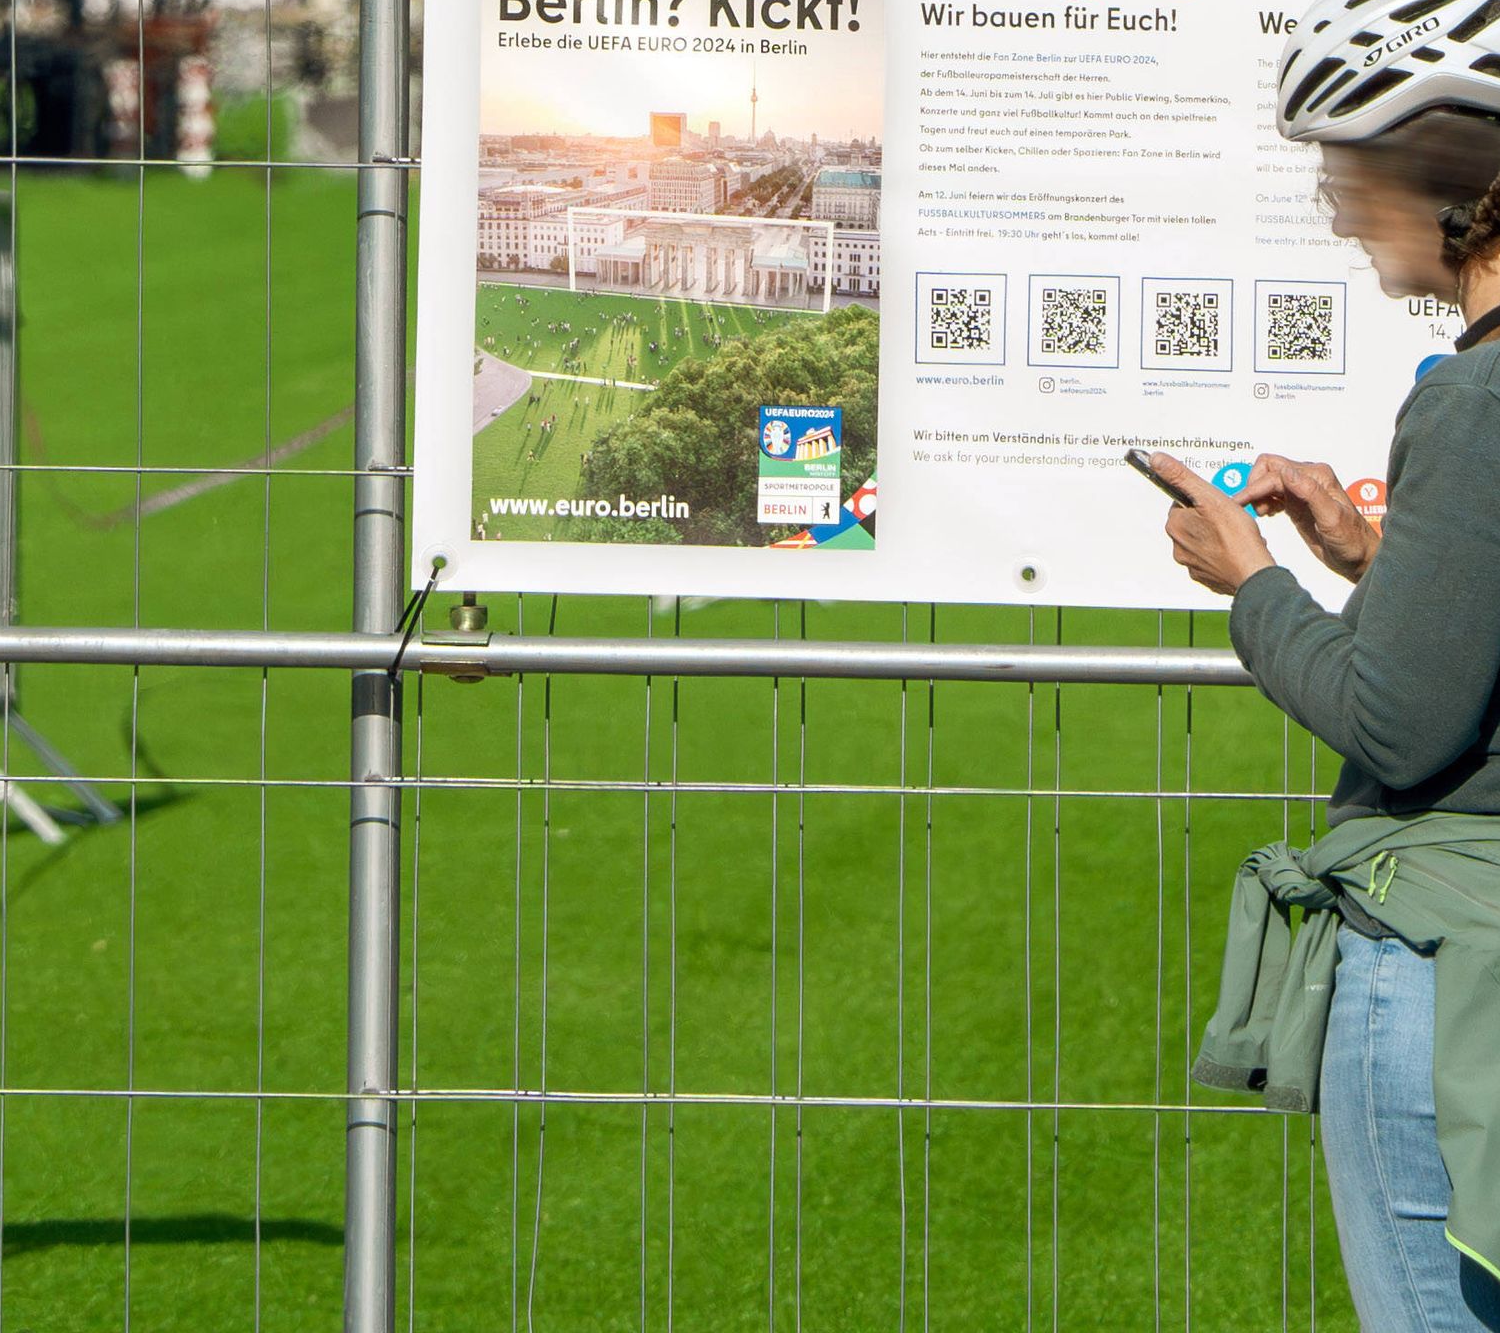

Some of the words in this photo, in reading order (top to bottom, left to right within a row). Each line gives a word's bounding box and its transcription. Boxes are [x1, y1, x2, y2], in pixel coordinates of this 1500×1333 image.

[921, 3, 964, 26] Wir
[973, 3, 1054, 29] bauen
[1064, 5, 1099, 30] für
[1108, 6, 1176, 31] Euch!
[499, 32, 551, 49] Erlebe
[557, 33, 582, 50] die
[589, 35, 631, 51] UEFA
[638, 36, 687, 52] EURO
[693, 37, 735, 53] 2024
[741, 38, 754, 54] in
[761, 39, 807, 55] Berlin
[1386, 17, 1440, 53] GIRO
[916, 376, 1004, 386] www.euro.berlin
[914, 430, 932, 441] Wir
[936, 430, 968, 442] bitten
[972, 434, 989, 442] um
[993, 431, 1060, 445] Verständnis
[1064, 434, 1078, 445] für
[1081, 434, 1099, 446] die
[1103, 435, 1253, 452] Verkehrseinschränkungen.
[490, 494, 689, 518] www.euro.berlin
[764, 504, 807, 515] BERLIN
